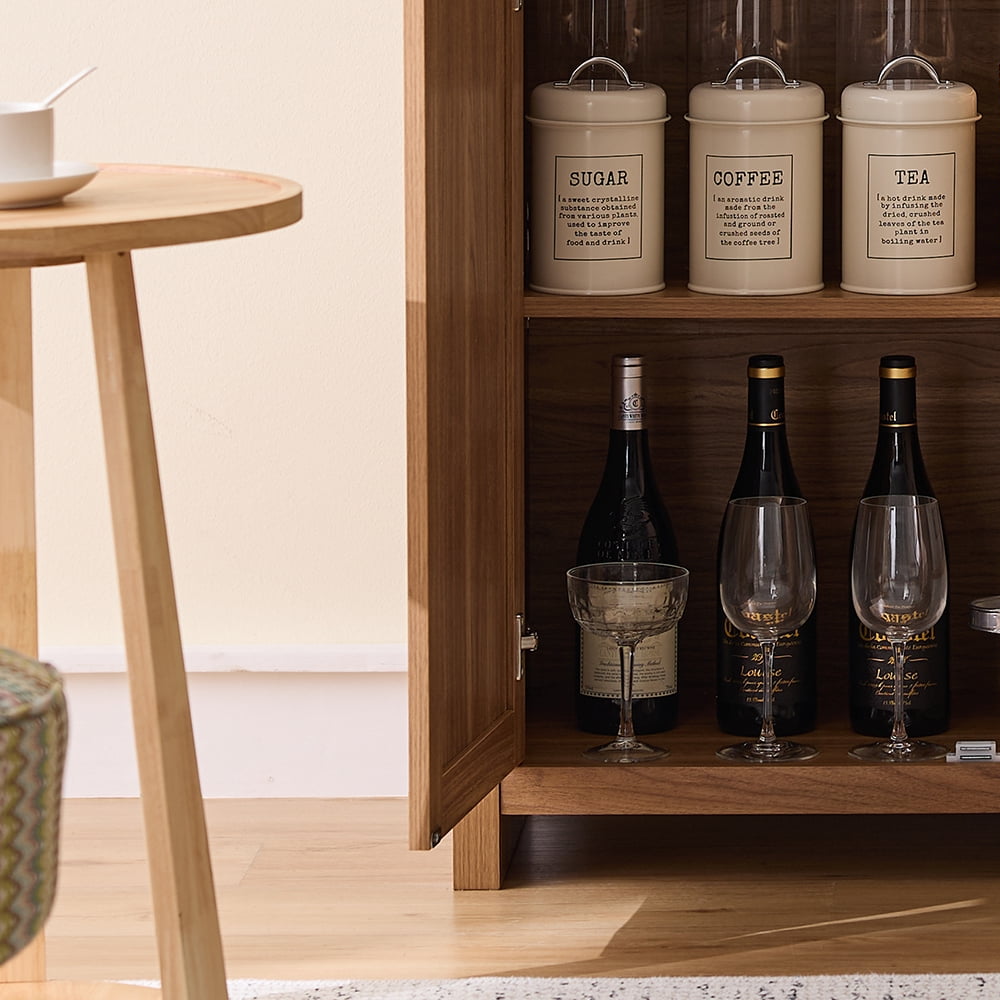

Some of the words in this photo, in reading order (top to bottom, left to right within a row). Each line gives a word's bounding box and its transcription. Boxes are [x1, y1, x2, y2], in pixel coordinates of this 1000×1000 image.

[569, 170, 629, 186] SUGAR
[713, 170, 784, 186] COFFEE
[894, 169, 930, 185] TEA
[591, 195, 639, 204] crystalline
[601, 203, 637, 211] obtained
[880, 202, 890, 210] by
[909, 210, 941, 218] crushed
[881, 237, 914, 245] boiling
[740, 665, 782, 677] Louse
[876, 668, 918, 681] Louse
